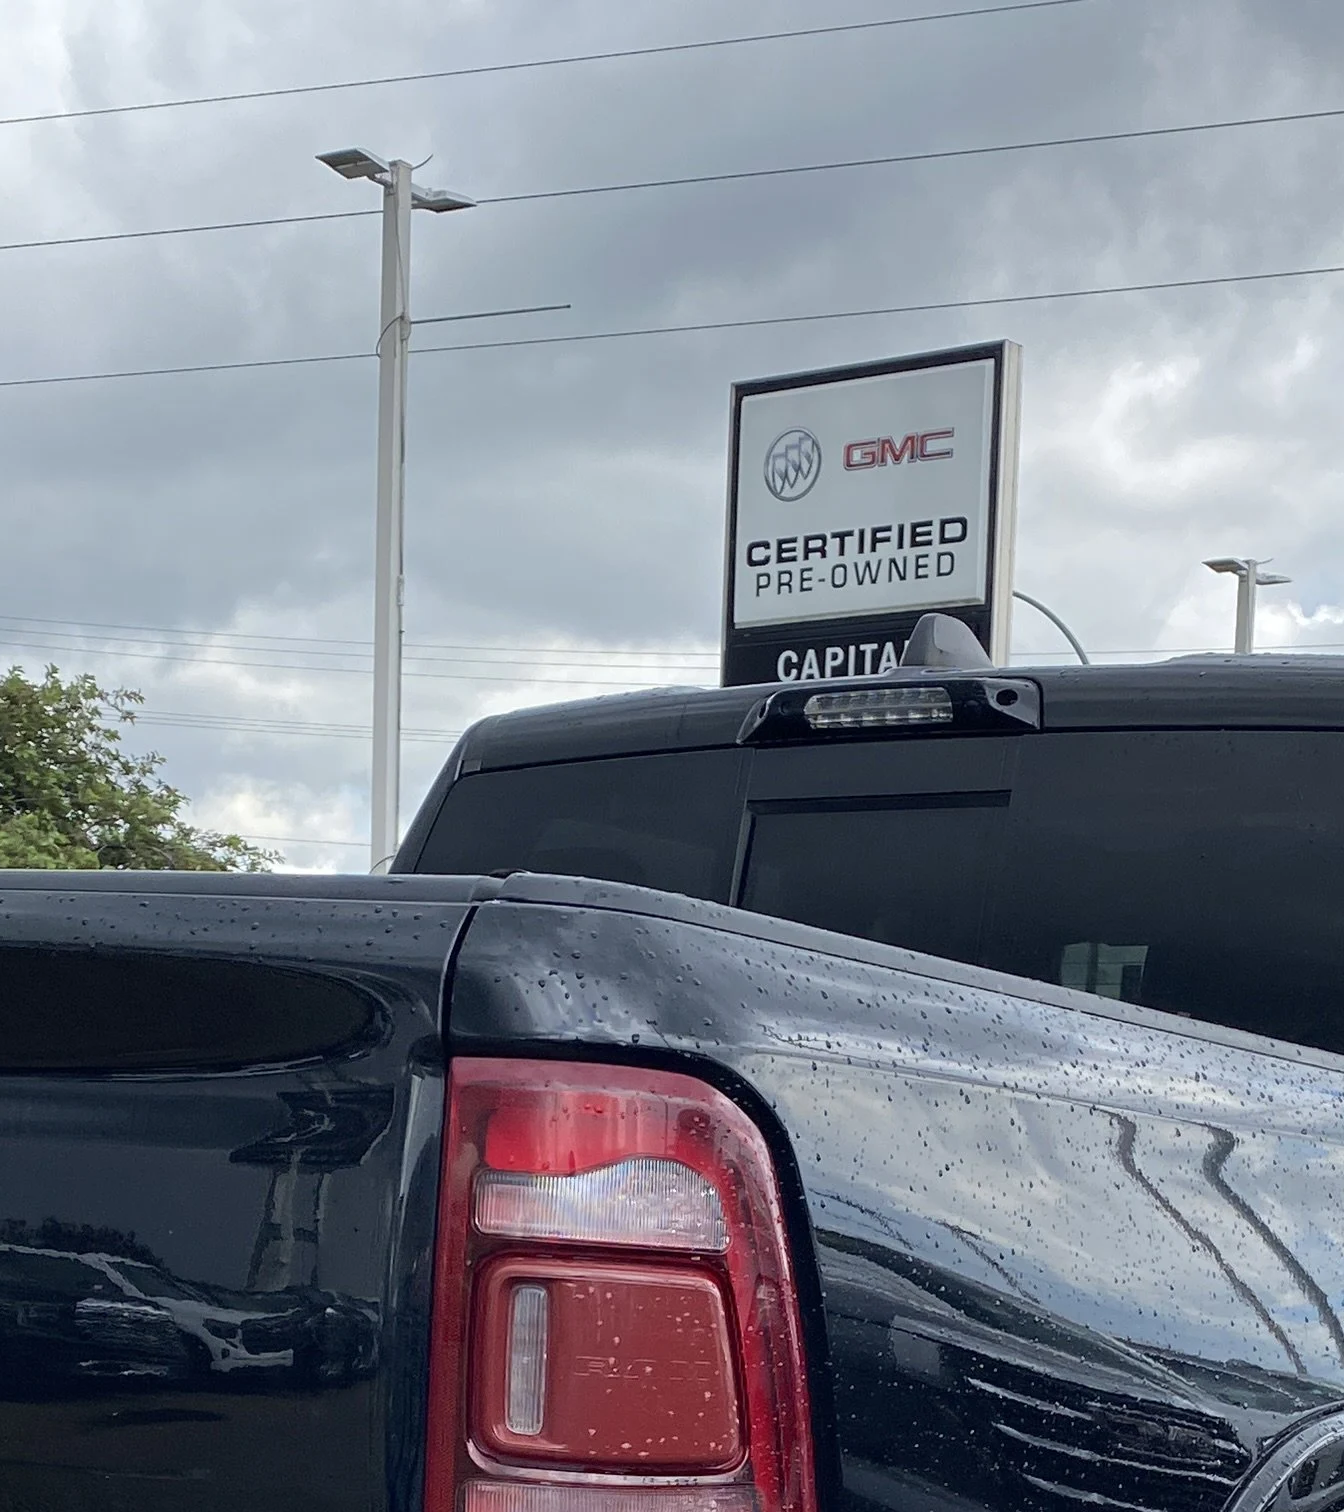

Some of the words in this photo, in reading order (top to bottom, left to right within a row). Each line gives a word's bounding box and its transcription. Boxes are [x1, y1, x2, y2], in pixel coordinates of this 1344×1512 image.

[843, 427, 954, 471] GMC
[746, 516, 968, 567] CERTIFIED
[755, 551, 956, 597] PRE-OWNED
[777, 640, 910, 681] CAPITA
